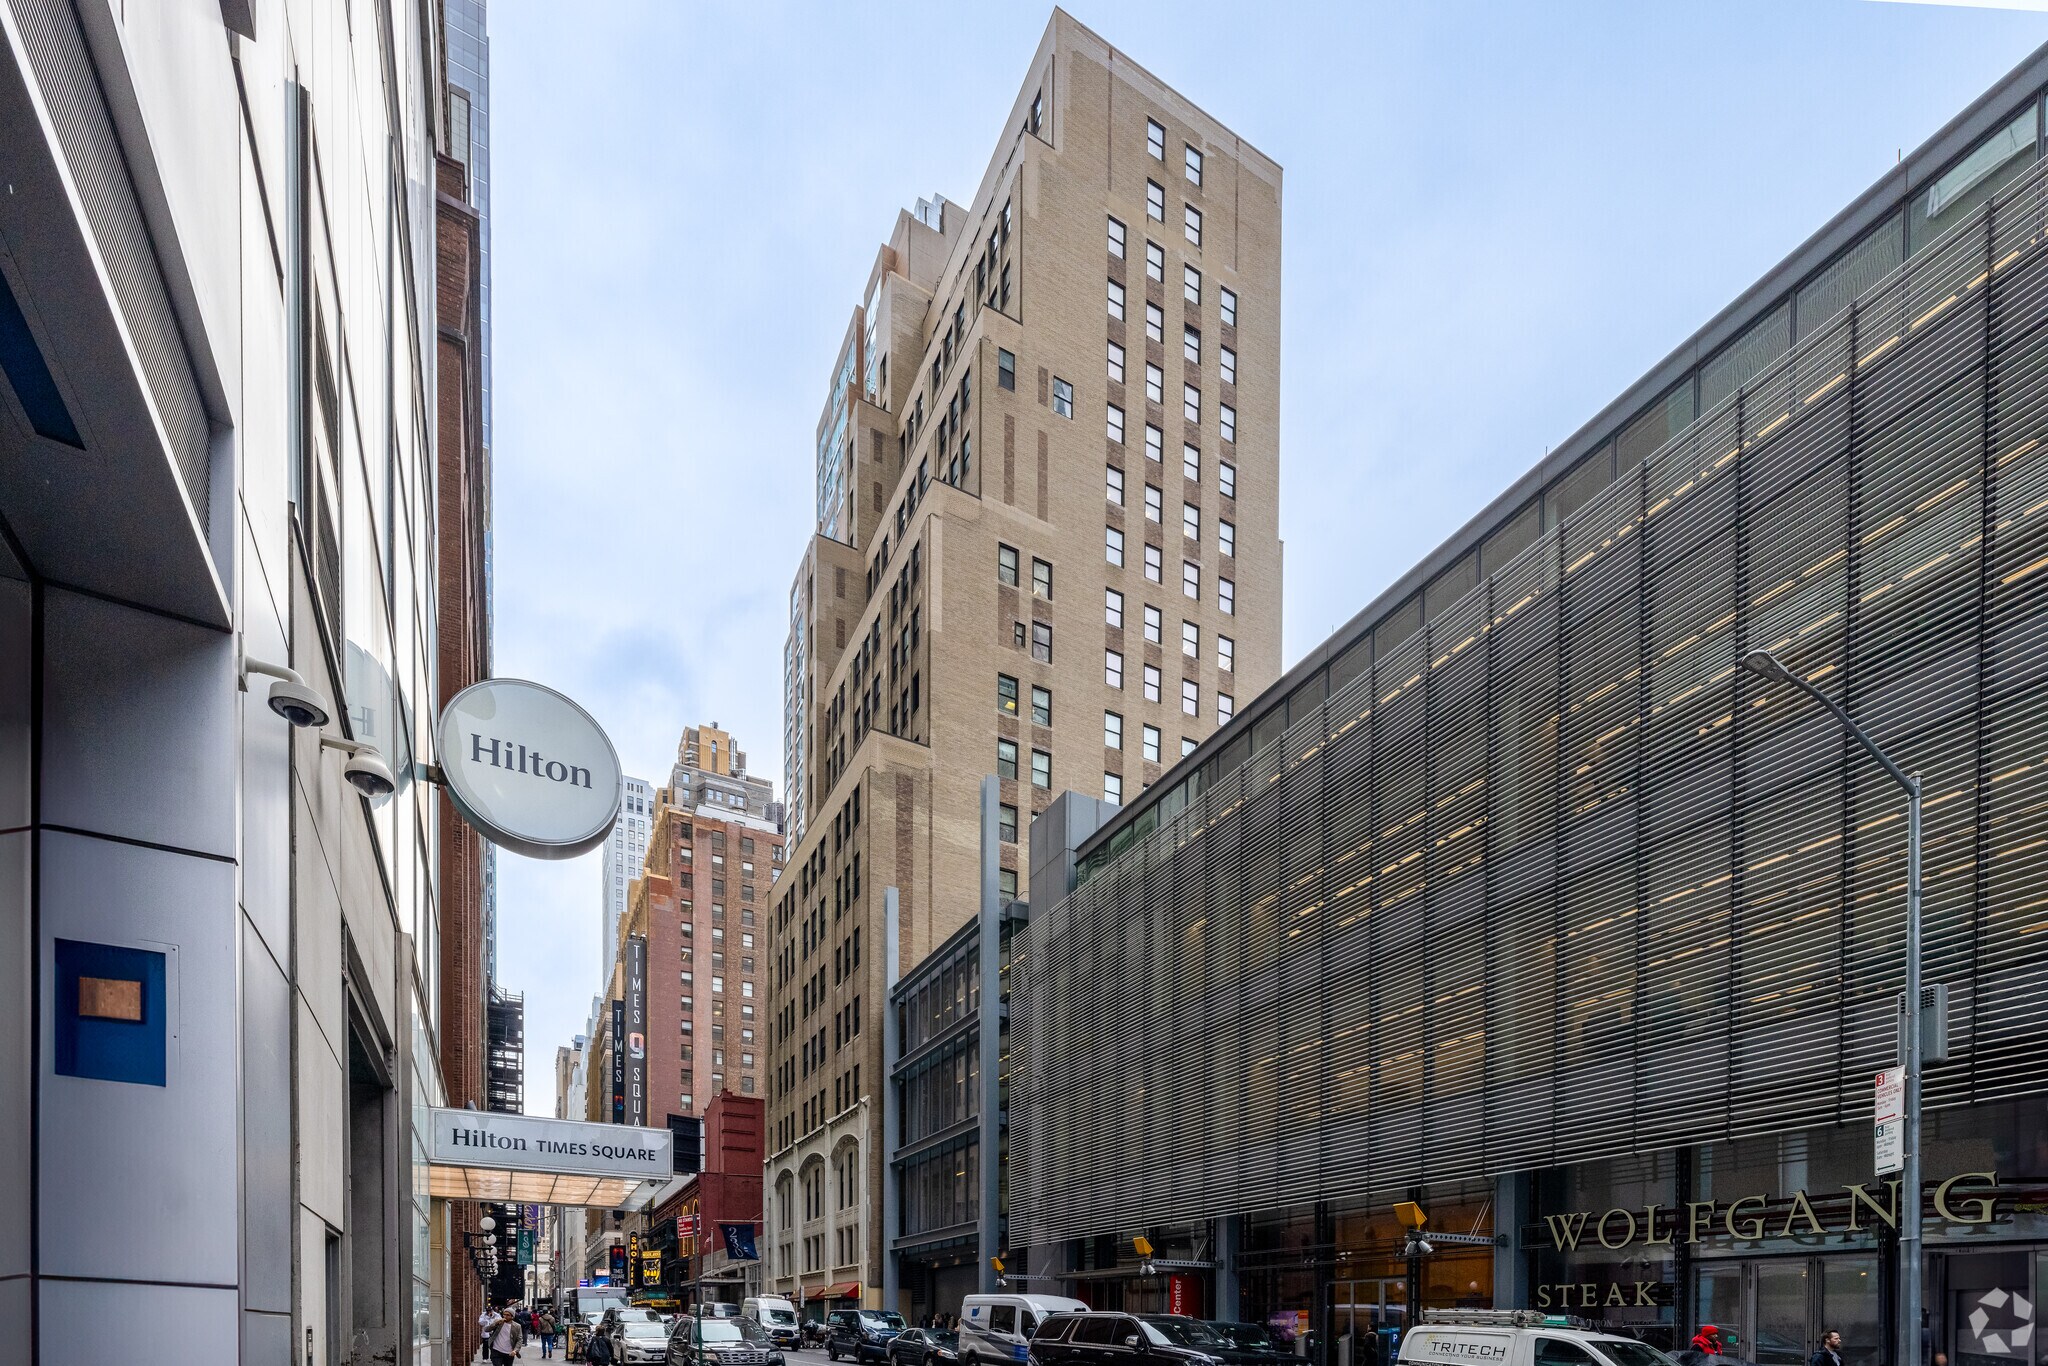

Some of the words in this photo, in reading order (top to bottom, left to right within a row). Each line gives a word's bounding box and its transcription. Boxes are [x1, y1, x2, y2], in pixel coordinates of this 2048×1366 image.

[471, 733, 592, 789] Hilton
[632, 944, 642, 1024] TIMES
[614, 1010, 623, 1083] TIMES
[1878, 1076, 1883, 1086] 3
[1878, 1083, 1898, 1094] COMMERCIAL
[1878, 1090, 1893, 1099] VEHICLES
[452, 1128, 527, 1150] Hilton
[536, 1140, 587, 1156] TIMES
[592, 1145, 656, 1162] SQUARE
[1876, 1126, 1882, 1137] 6
[1543, 1170, 1998, 1252] WOLFGANG
[1174, 1279, 1182, 1314] Center
[1538, 1281, 1658, 1308] STEAK
[1392, 1334, 1398, 1342] P
[1432, 1342, 1506, 1357] TRITECH
